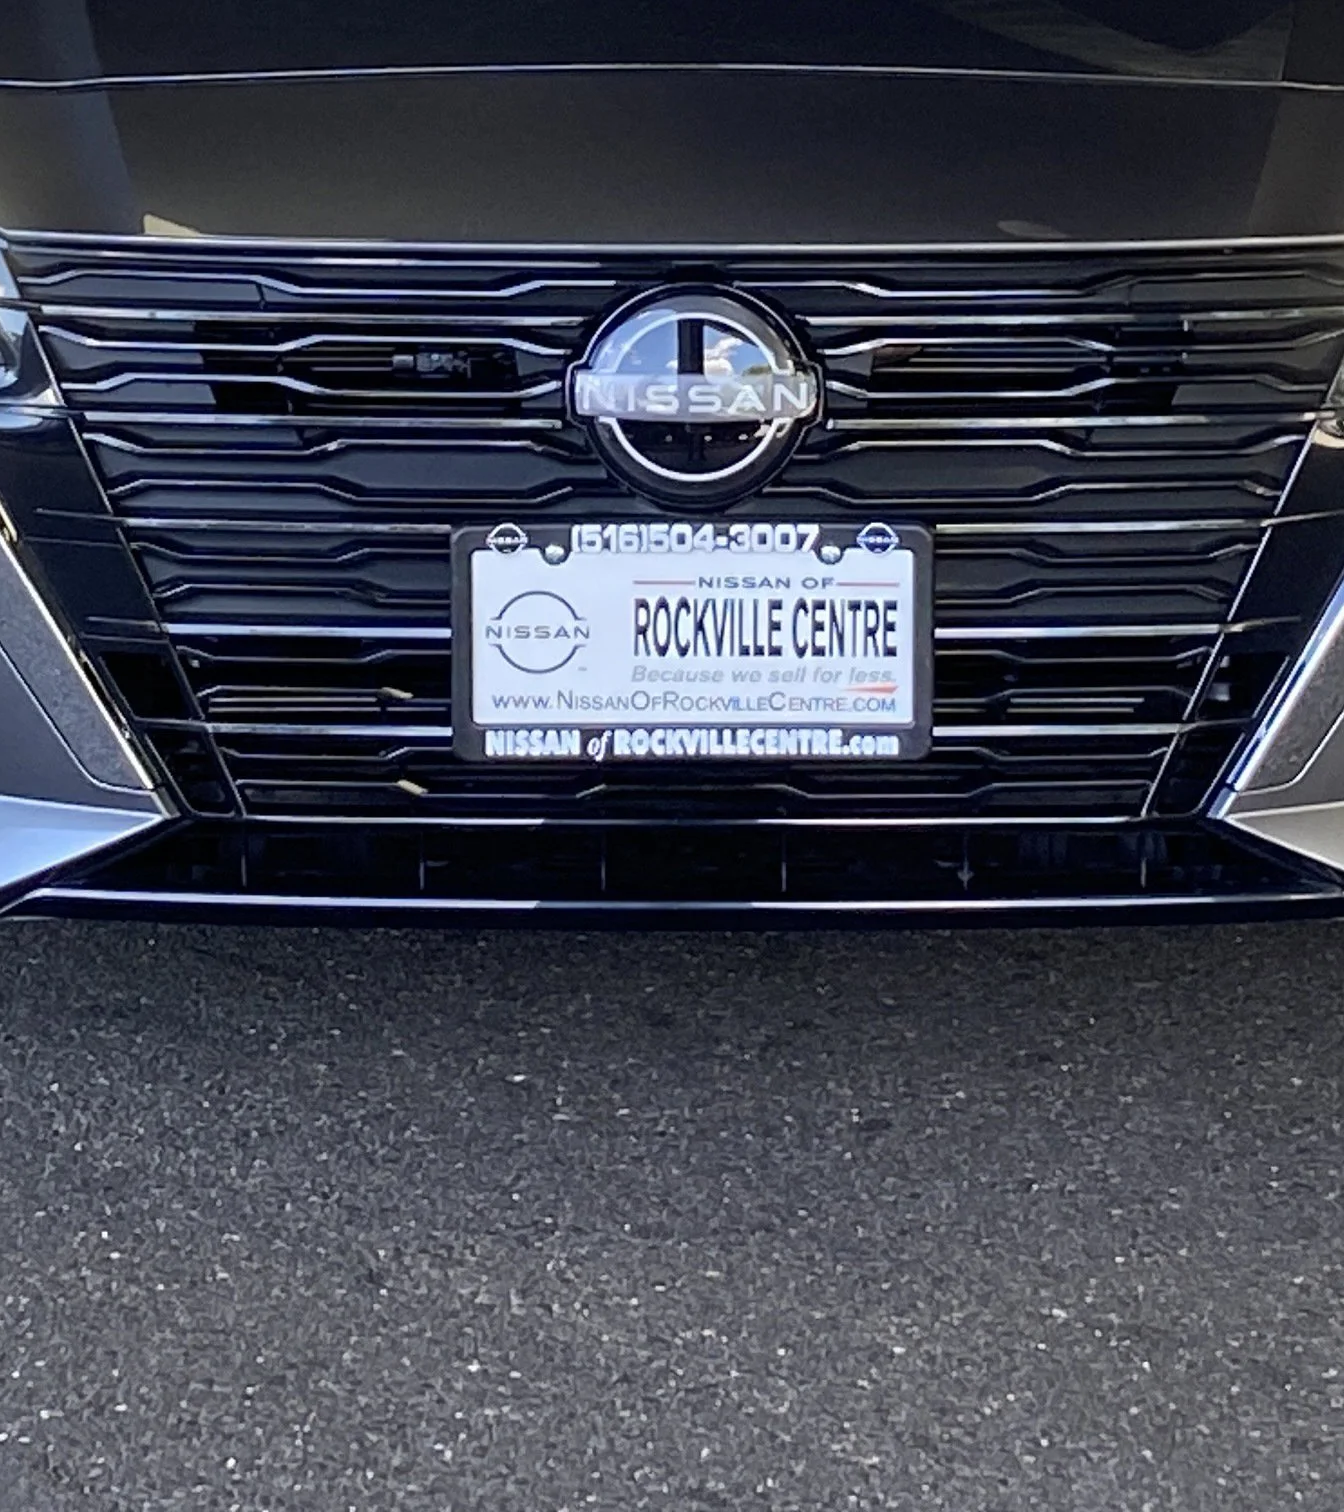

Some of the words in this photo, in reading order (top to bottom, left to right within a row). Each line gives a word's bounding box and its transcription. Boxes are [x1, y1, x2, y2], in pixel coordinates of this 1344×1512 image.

[582, 383, 808, 413] NISSAN
[572, 523, 820, 553] (516)504-3007
[697, 576, 791, 589] NISSAN
[801, 576, 836, 589] OF
[485, 625, 590, 639] NISSAN
[633, 595, 783, 658] ROCKVILLE
[792, 596, 899, 659] CENTRE
[631, 665, 724, 683] Because
[731, 670, 762, 683] we
[767, 666, 805, 683] sell
[812, 666, 843, 683] for
[848, 667, 897, 684] less.
[485, 729, 581, 758] NISSAN
[587, 730, 613, 763] of
[614, 728, 900, 757] ROCKVILLECENTRE.com
